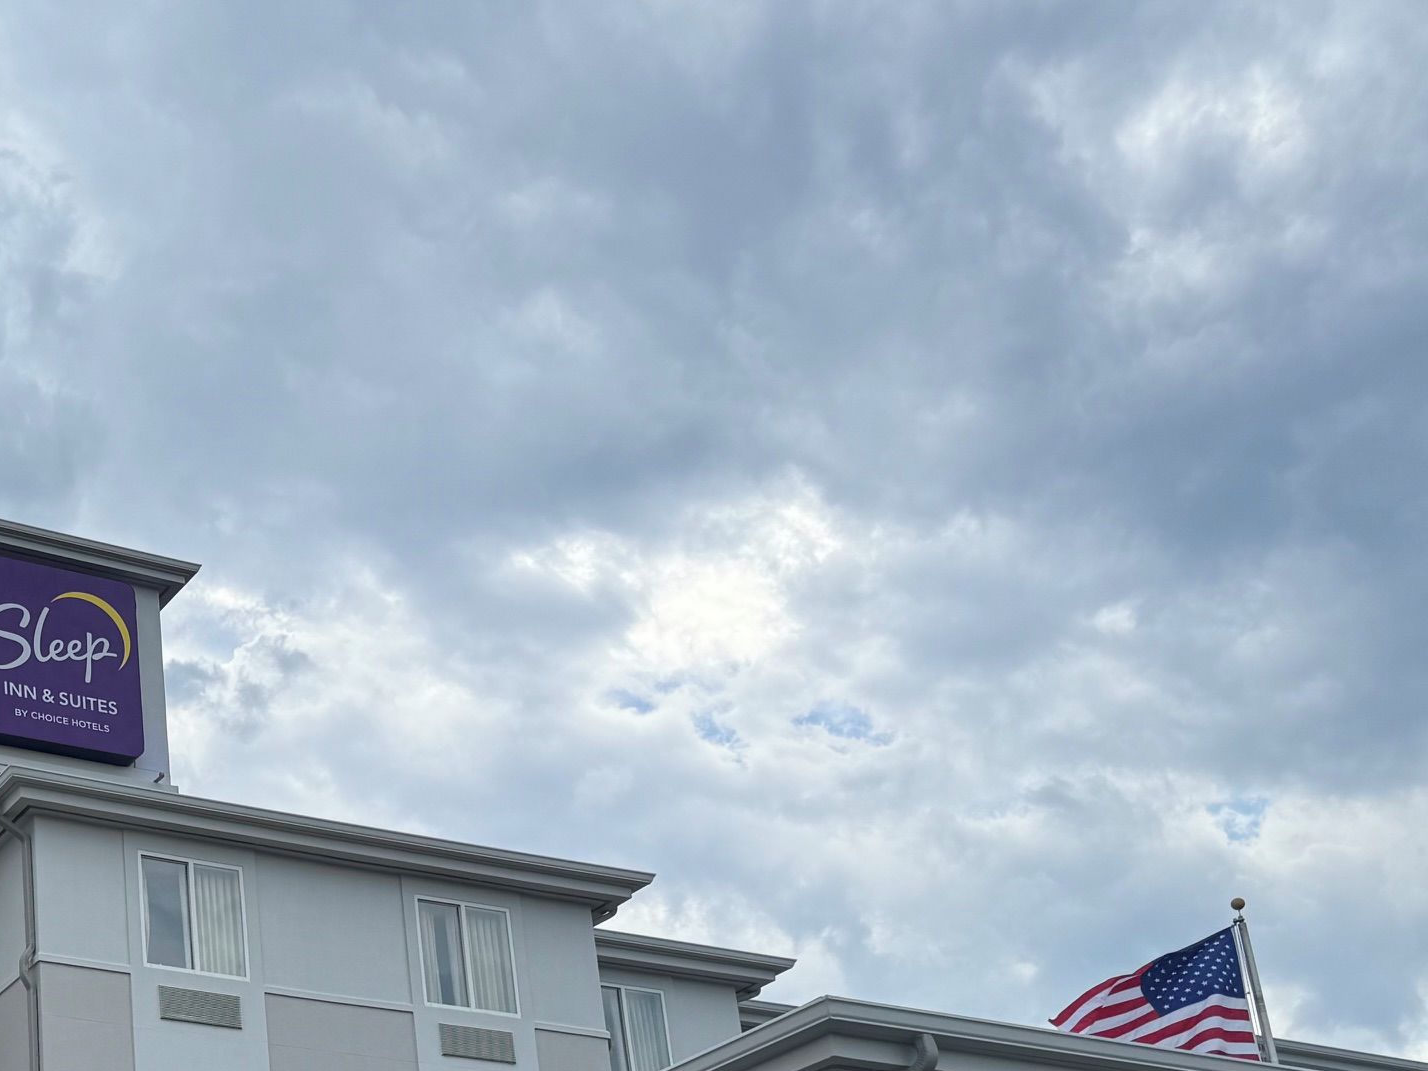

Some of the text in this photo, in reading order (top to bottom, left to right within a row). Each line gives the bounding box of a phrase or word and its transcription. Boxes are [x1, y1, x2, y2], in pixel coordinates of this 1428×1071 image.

[3, 680, 118, 715] INN & SUITES
[14, 708, 110, 733] BY CHOICE HOTELS
